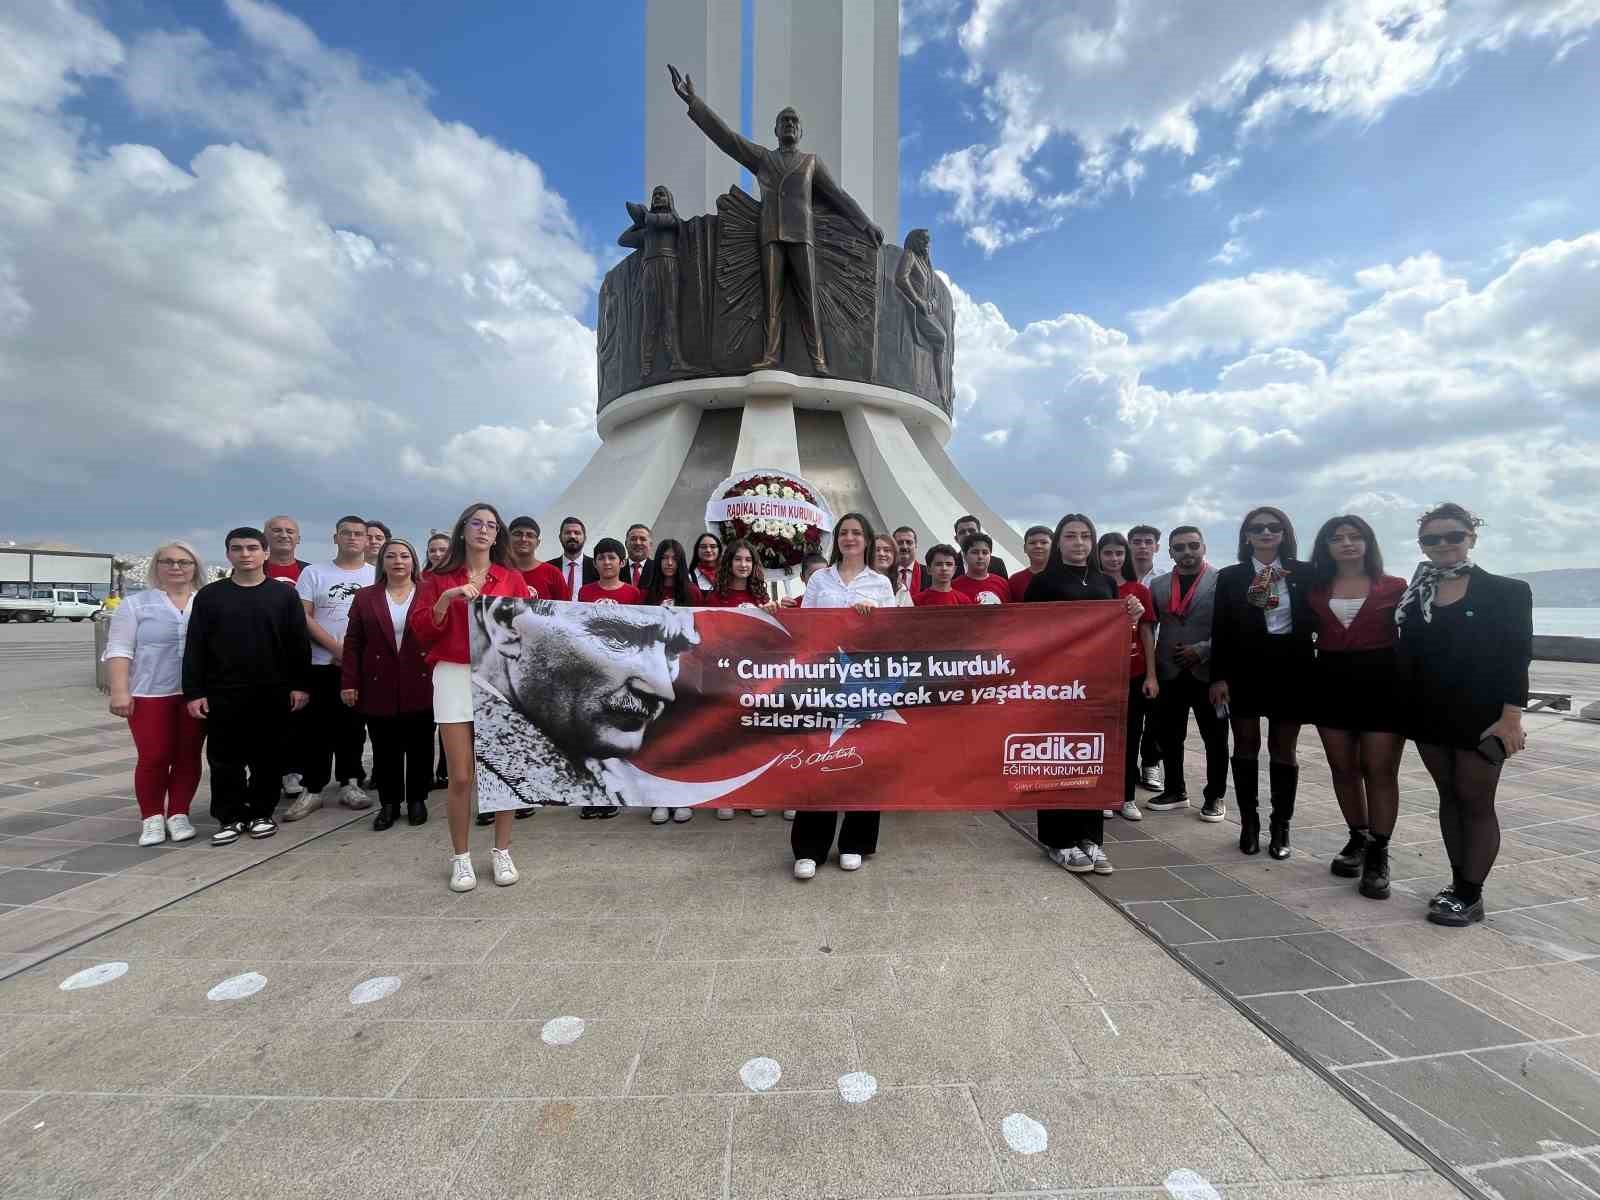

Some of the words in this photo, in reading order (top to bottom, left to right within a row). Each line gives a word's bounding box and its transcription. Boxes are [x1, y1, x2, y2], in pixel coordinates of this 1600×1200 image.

[737, 657, 881, 684] Cumhuriyeti
[887, 656, 923, 678] biz
[928, 653, 1016, 677] kurduk,
[740, 692, 785, 708] onu
[791, 685, 932, 711] yükseltecek
[938, 688, 964, 703] ve
[971, 680, 1087, 705] yaşatacak
[740, 711, 861, 729] sizlersiniz.
[1009, 736, 1100, 760] radikal
[1003, 763, 1041, 776] EĞİTİM
[1043, 764, 1104, 776] KURUMLARI
